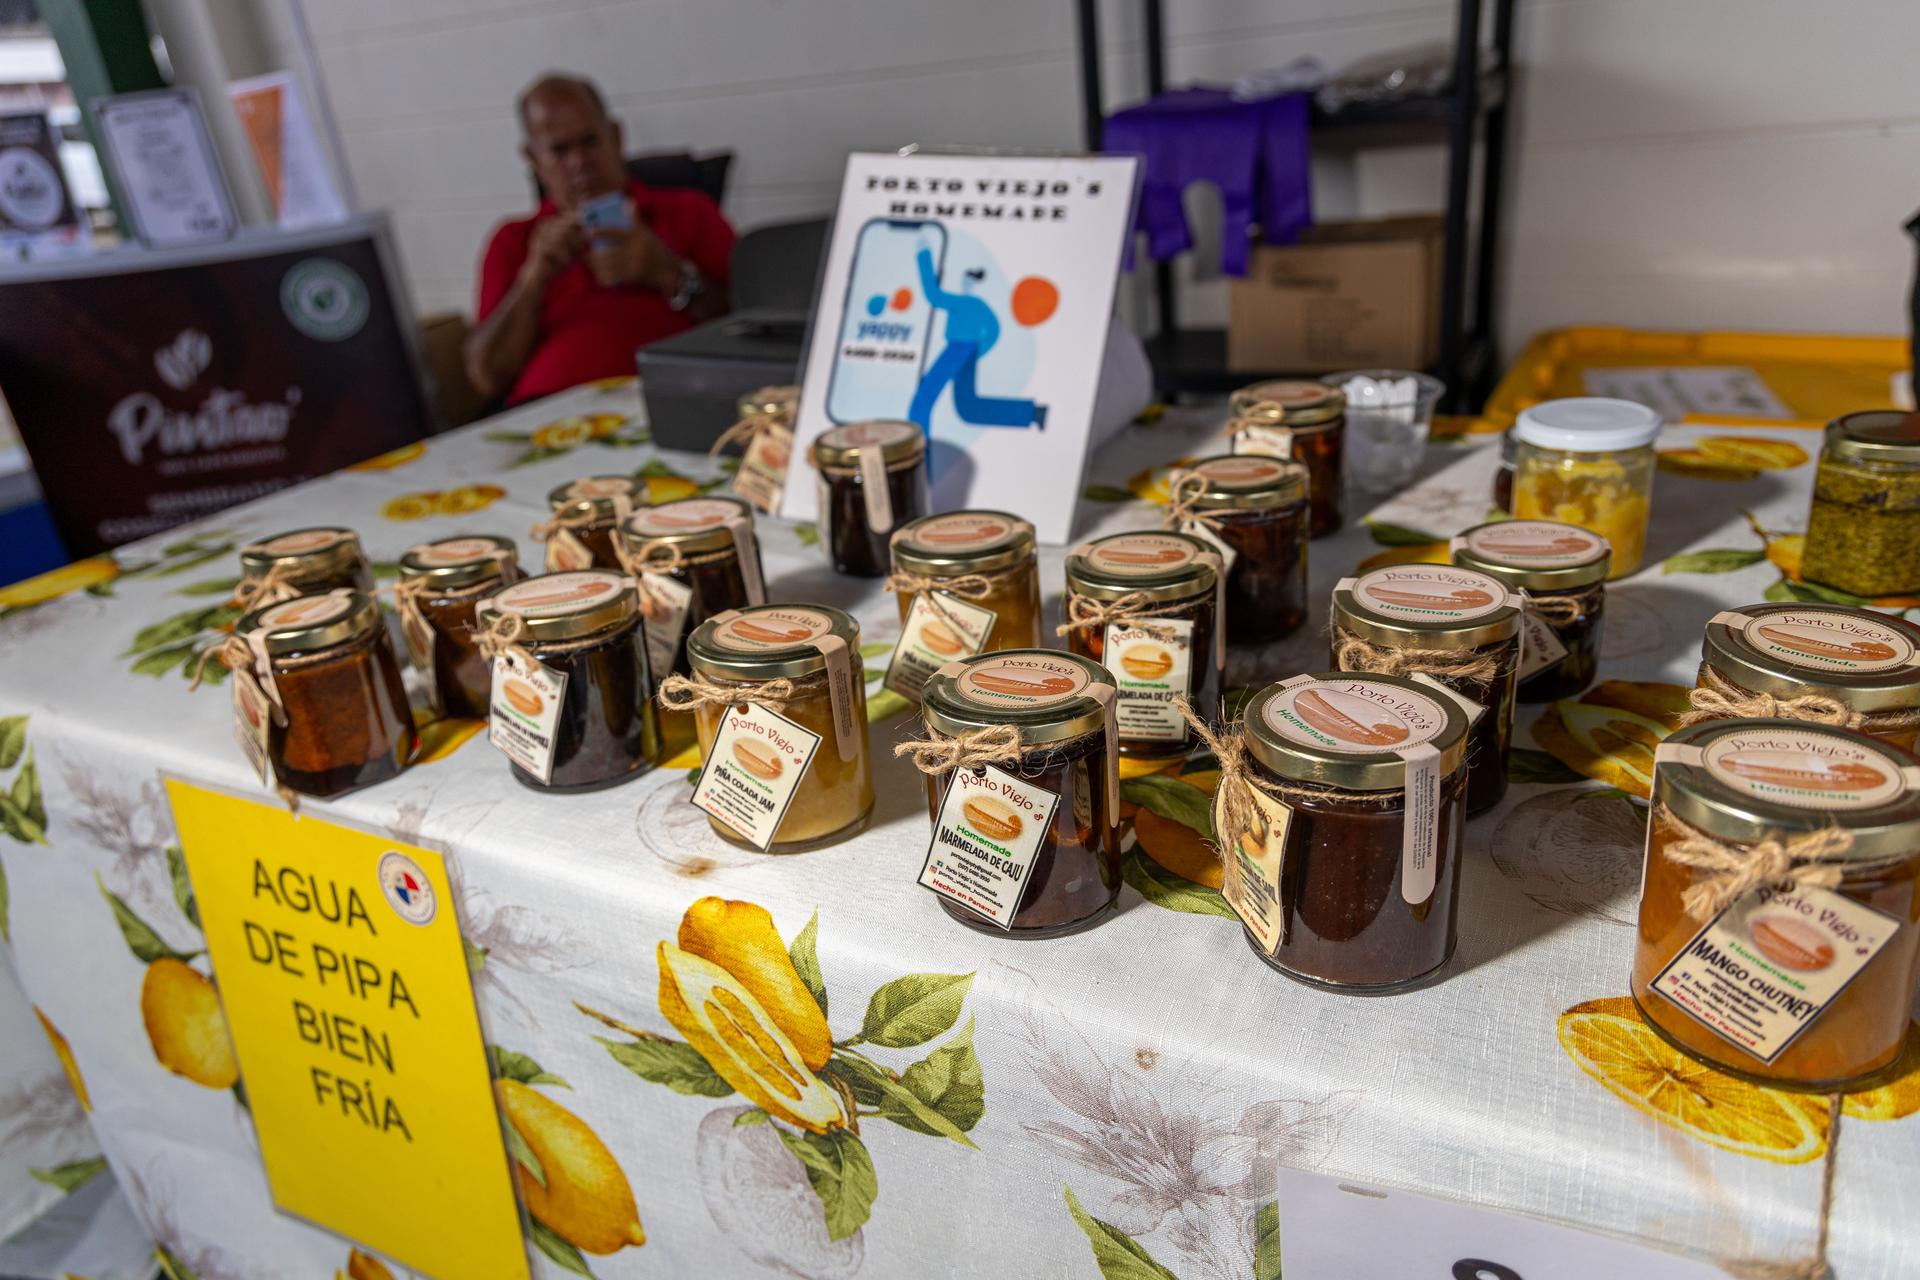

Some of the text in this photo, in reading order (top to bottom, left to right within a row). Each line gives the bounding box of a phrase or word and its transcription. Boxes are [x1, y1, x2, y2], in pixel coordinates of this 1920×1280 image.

[865, 176, 963, 192] PORTO
[889, 201, 1068, 220] HOMEMADE
[1383, 572, 1432, 582] Porto
[1379, 603, 1463, 617] Homemade
[1111, 630, 1145, 647] Porto
[1782, 615, 1895, 643] Porto Viejo's
[1002, 659, 1039, 669] Porto
[1769, 645, 1858, 669] Homemade
[971, 688, 1038, 703] Homemade
[1344, 683, 1431, 732] Porto Viejo's
[729, 716, 765, 736] Porto
[1276, 708, 1338, 747] Homemade
[1729, 738, 1790, 751] Porto
[714, 765, 776, 813] PIÑA COLADA JAM
[725, 760, 773, 795] Homemade
[959, 773, 998, 791] Porto
[1750, 782, 1862, 802] Homemade
[939, 826, 1025, 882] MARMELADA DE CAJU
[956, 825, 1013, 858] Homemade
[254, 858, 378, 937] AGUA
[932, 878, 957, 896] Hecho
[968, 895, 998, 917] Panamá
[972, 877, 998, 897] Homemade
[1757, 887, 1815, 916] Porto
[243, 920, 420, 1019] DE PIPA
[1690, 938, 1819, 1021] MANGO CHUTNEY
[1727, 941, 1807, 991] Homemade
[1672, 988, 1703, 1015] Hecho
[293, 1000, 396, 1074] BIEN
[310, 1066, 414, 1143] FRÍA
